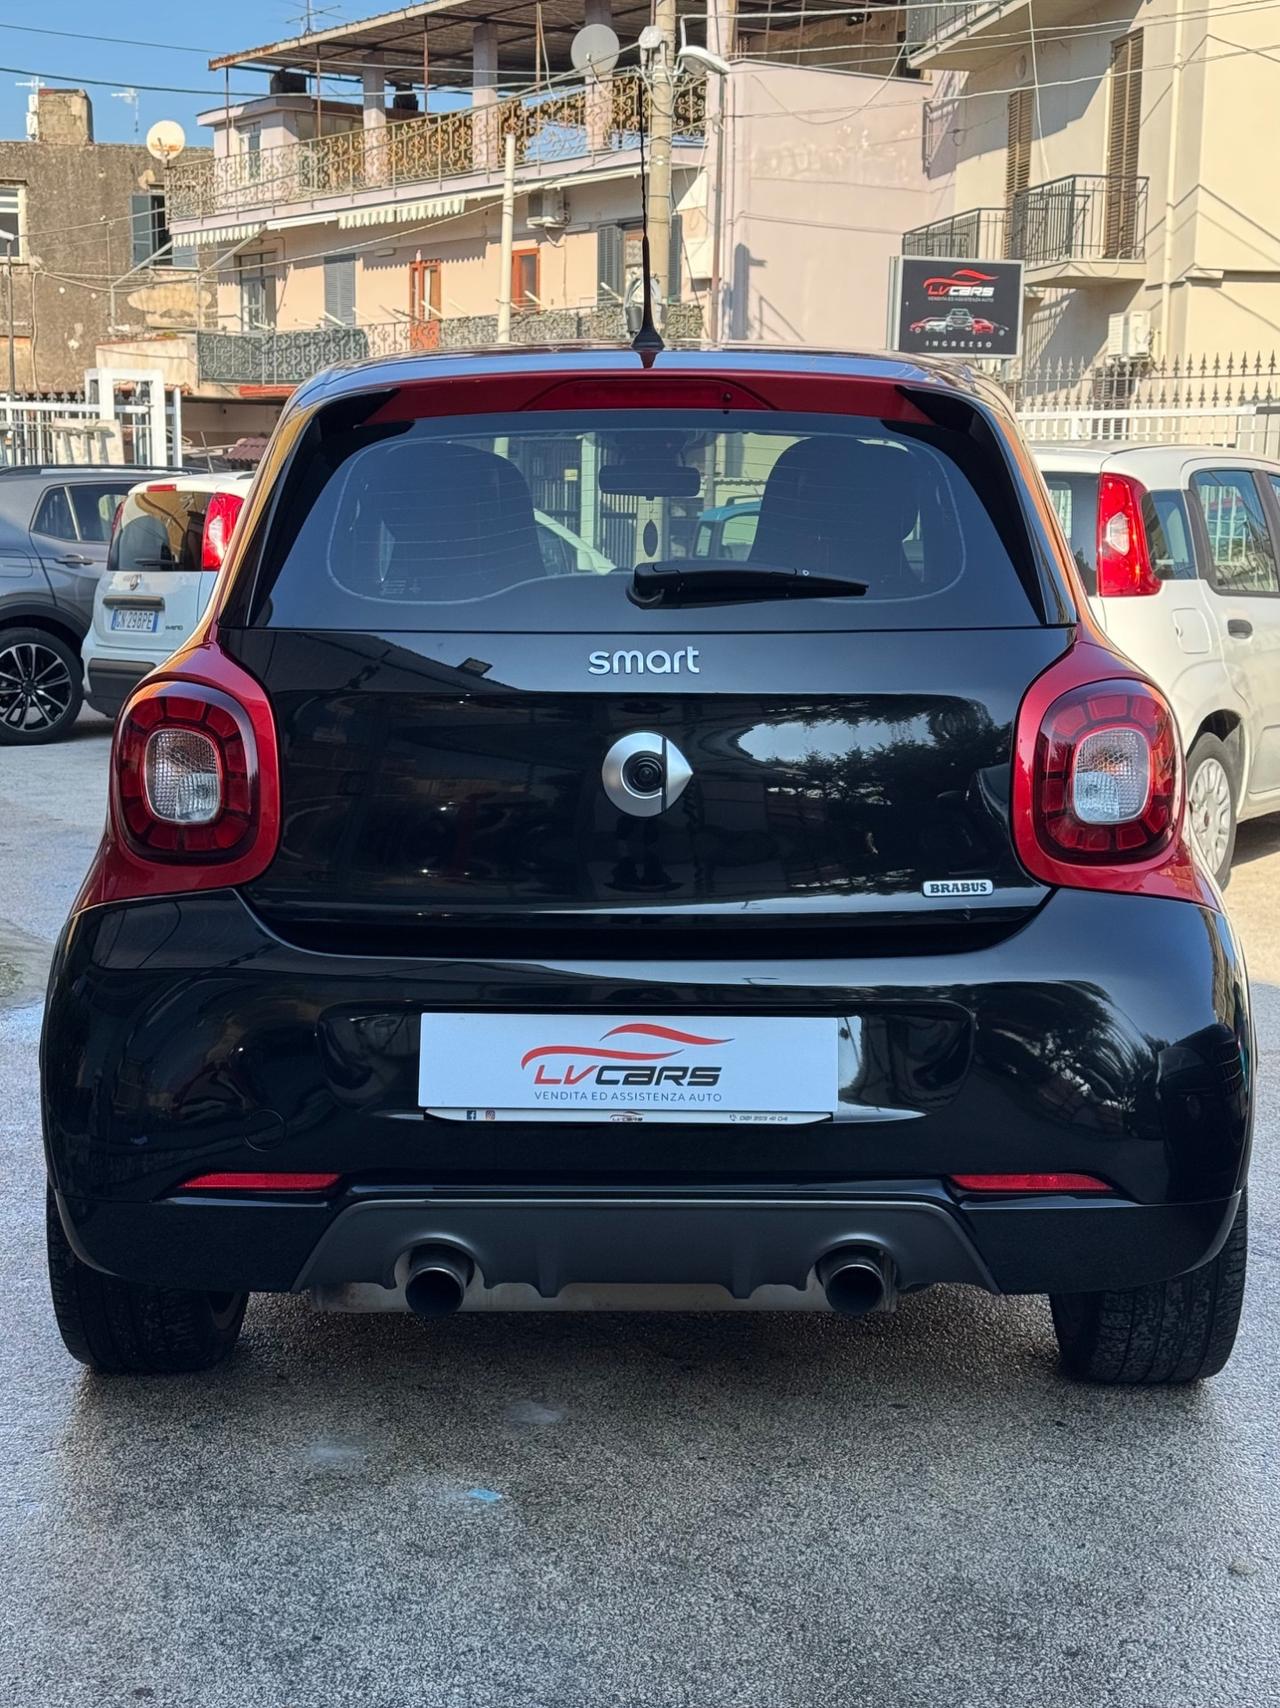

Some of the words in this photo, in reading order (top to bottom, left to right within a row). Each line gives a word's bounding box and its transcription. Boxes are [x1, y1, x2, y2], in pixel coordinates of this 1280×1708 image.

[588, 646, 700, 675] smart
[930, 882, 988, 893] BRABUS
[534, 1091, 587, 1101] VENDITA
[591, 1091, 608, 1101] ED
[611, 1092, 685, 1102] ASSISTENZA
[688, 1093, 722, 1102] AUTO
